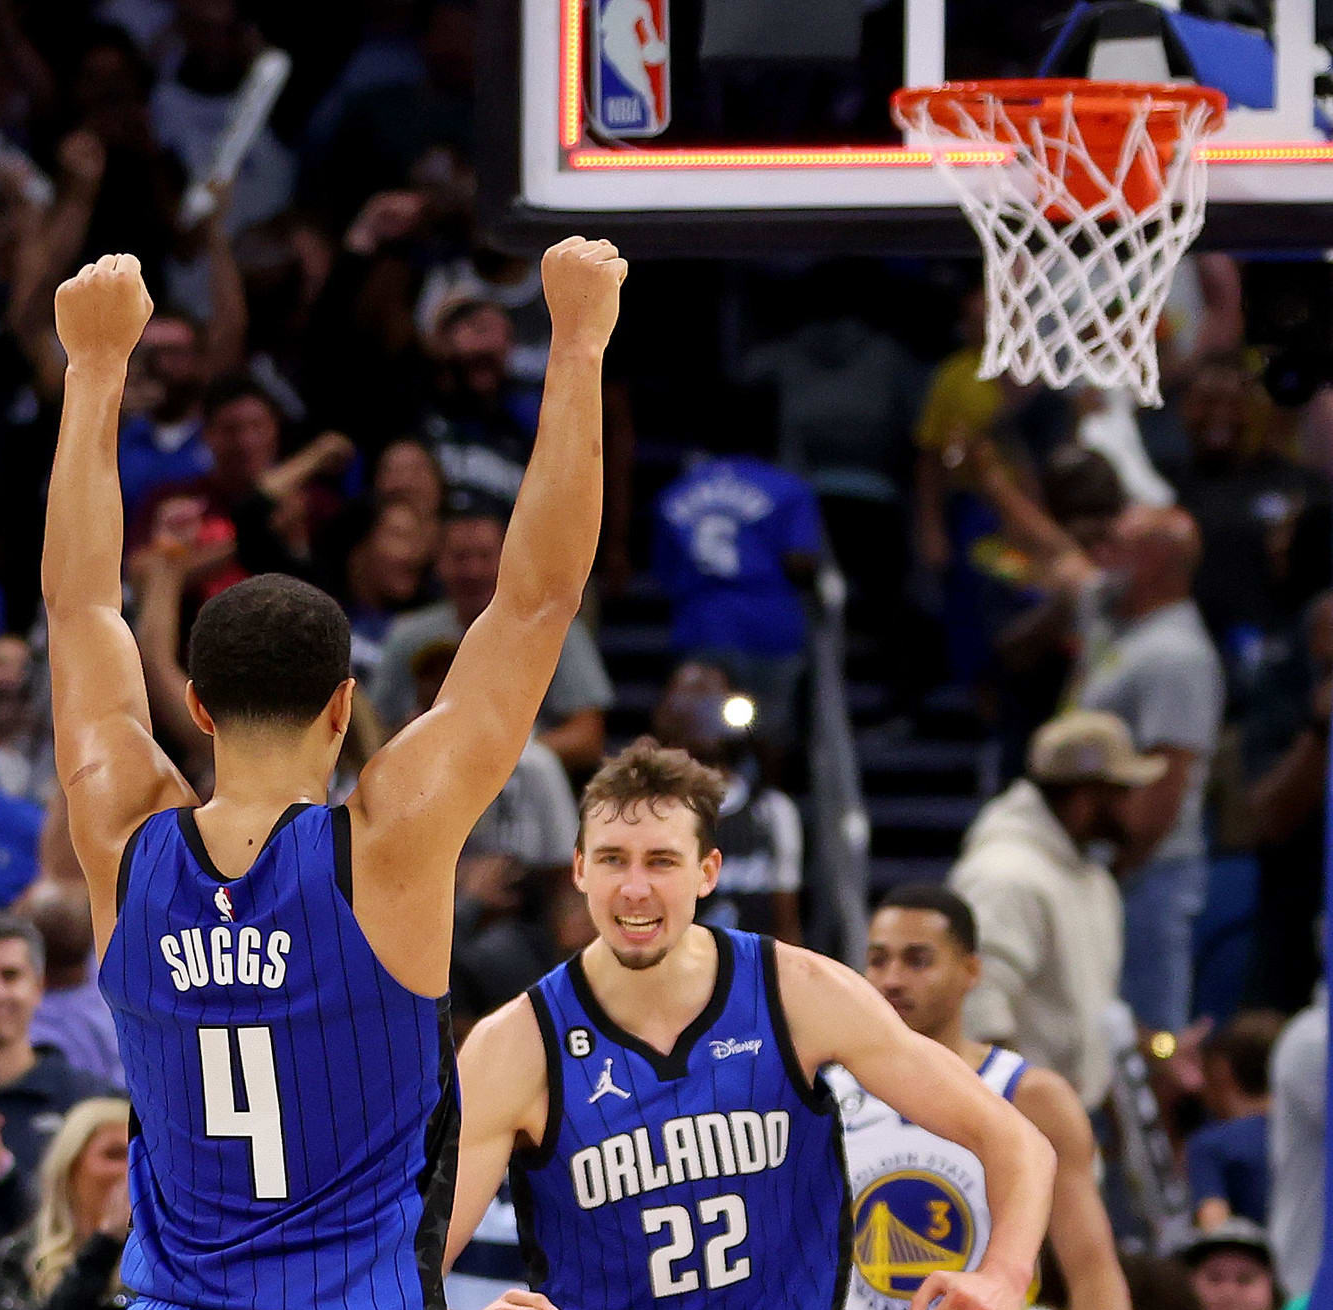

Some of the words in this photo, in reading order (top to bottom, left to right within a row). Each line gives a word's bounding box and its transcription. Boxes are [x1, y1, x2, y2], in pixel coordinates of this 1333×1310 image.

[607, 97, 643, 122] NBA
[160, 926, 291, 991] SUGGS
[568, 1029, 591, 1057] 6
[709, 1038, 763, 1060] Disney
[198, 1025, 289, 1200] 4
[571, 1110, 790, 1210] ORLANDO
[642, 1193, 751, 1298] 22
[927, 1201, 952, 1240] 3
